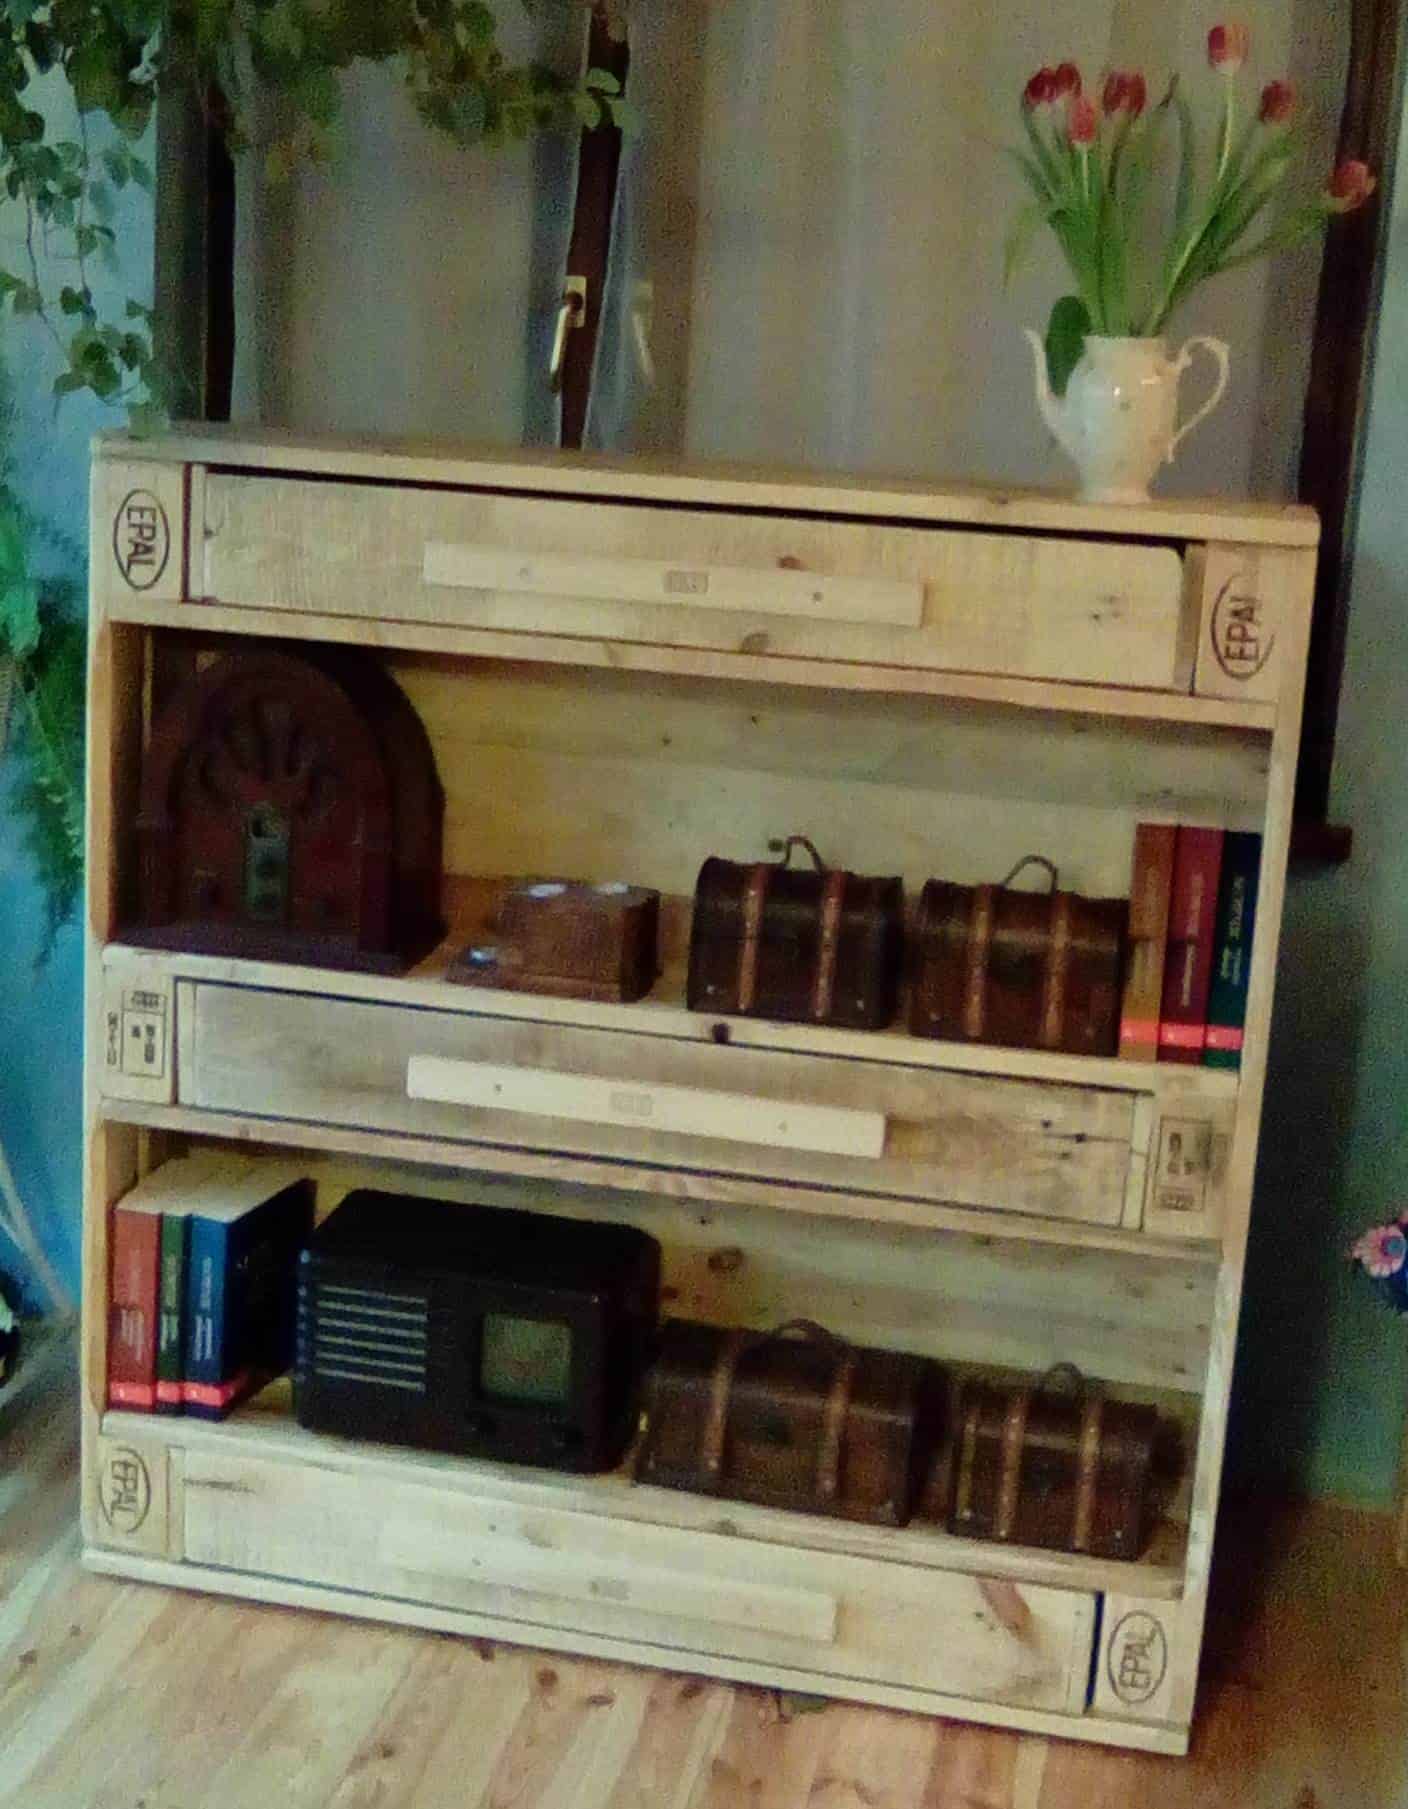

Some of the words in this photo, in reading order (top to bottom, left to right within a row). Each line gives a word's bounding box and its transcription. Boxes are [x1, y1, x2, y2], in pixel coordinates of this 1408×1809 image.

[127, 505, 156, 577] EPAL
[111, 1460, 138, 1518] EPAL
[1118, 1629, 1156, 1689] EPAL
